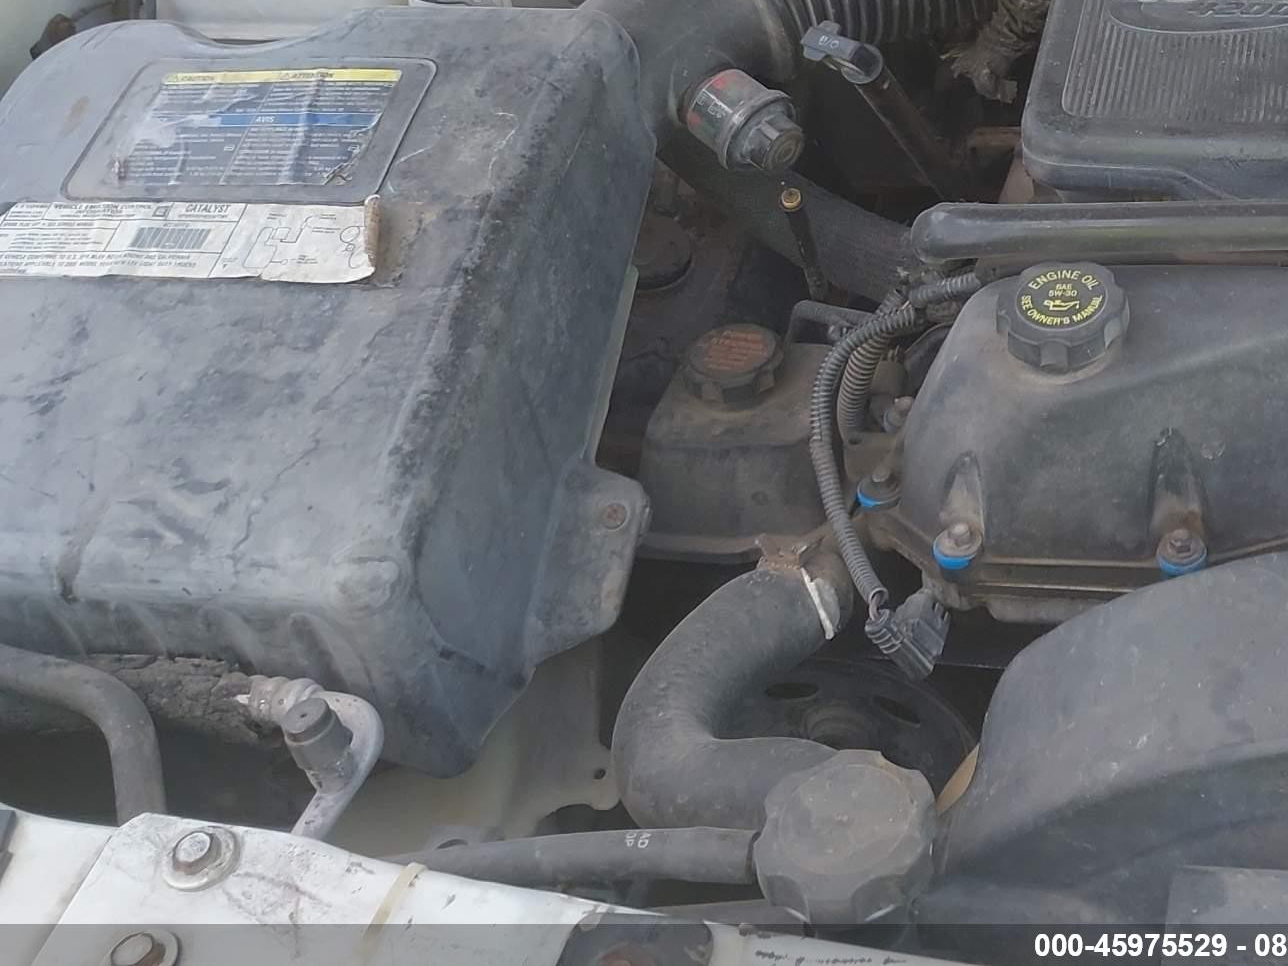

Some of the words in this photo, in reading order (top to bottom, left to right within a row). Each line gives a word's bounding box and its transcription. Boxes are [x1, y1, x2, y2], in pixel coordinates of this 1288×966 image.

[185, 204, 231, 213] CATALYST
[1028, 269, 1081, 290] ENGINE
[1081, 275, 1099, 291] OIL
[1021, 295, 1034, 311] SEE
[1072, 295, 1103, 323] MANUAL
[1027, 307, 1071, 326] OWNER'S
